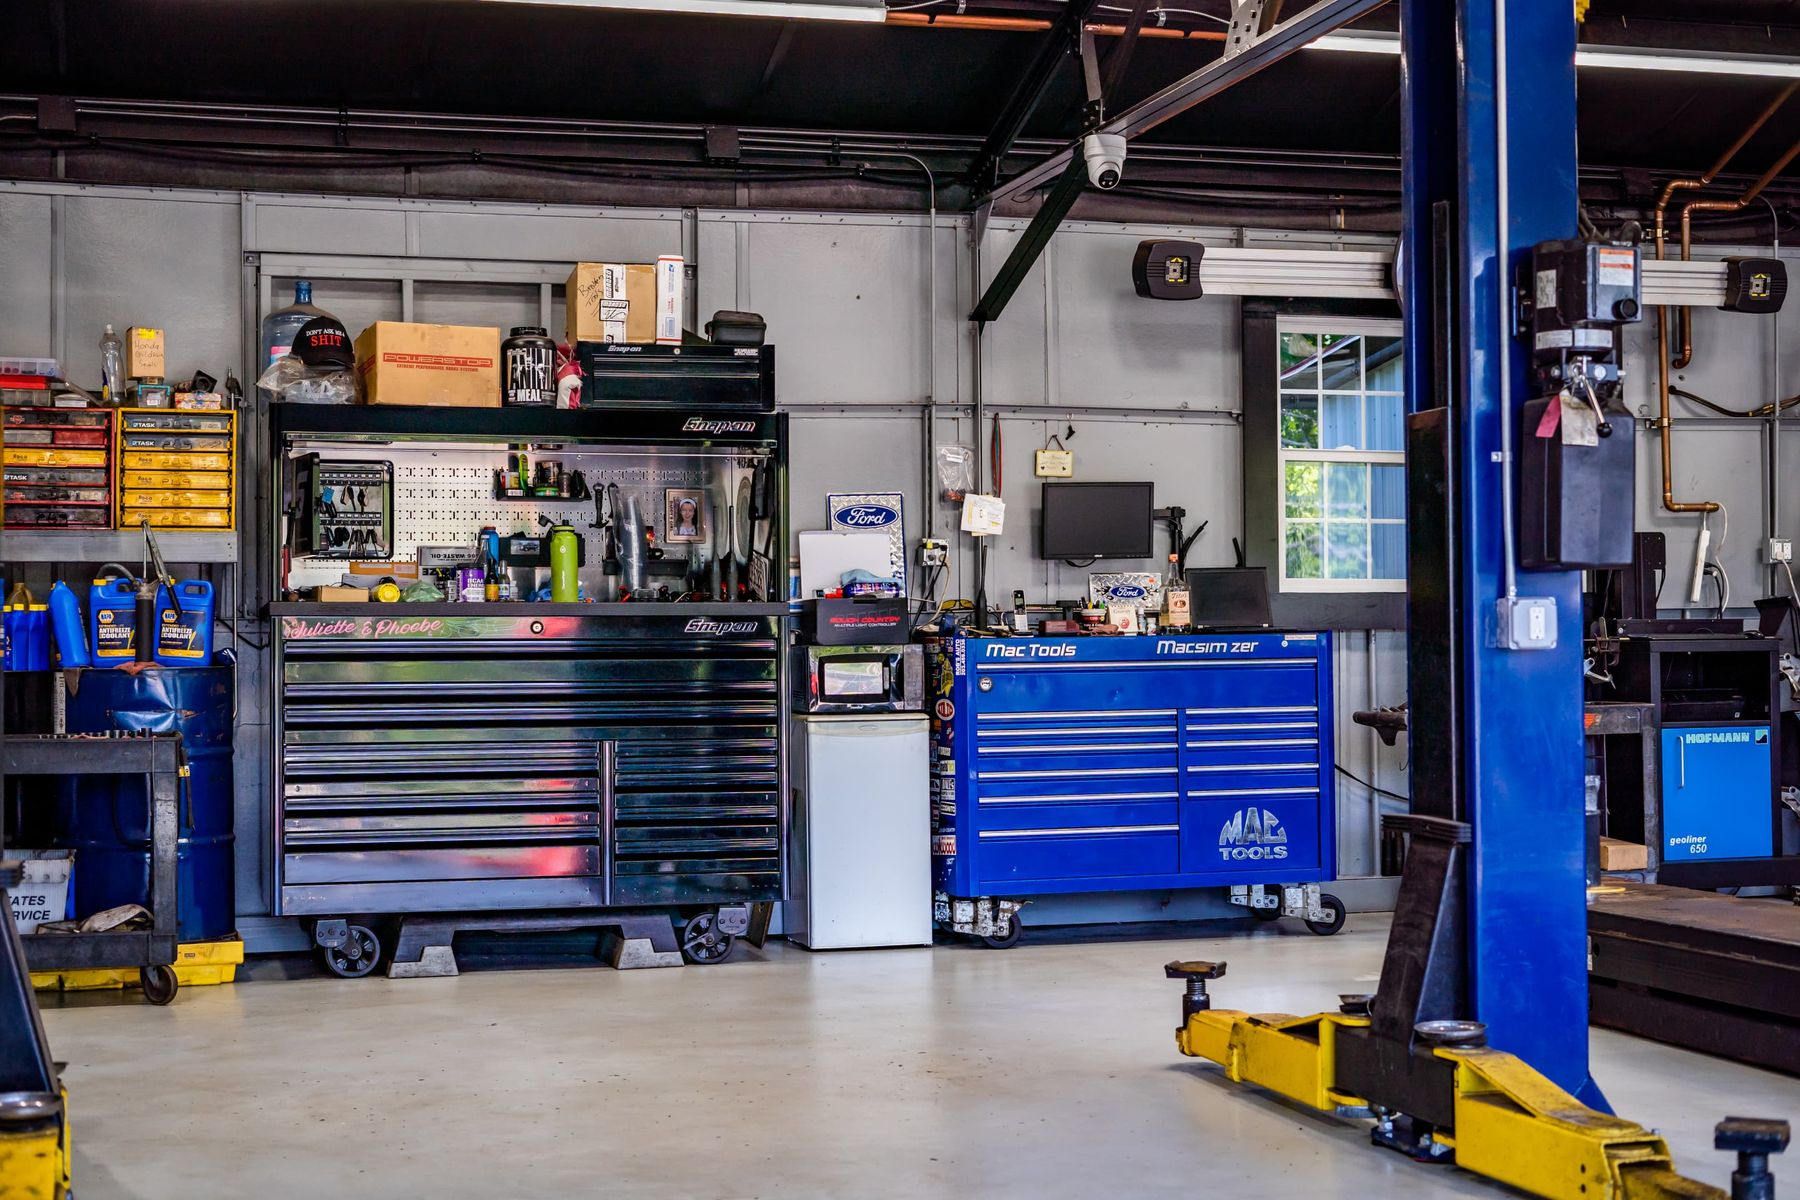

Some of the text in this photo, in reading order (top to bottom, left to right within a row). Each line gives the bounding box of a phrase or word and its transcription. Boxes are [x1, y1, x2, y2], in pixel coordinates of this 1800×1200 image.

[311, 334, 342, 347] SHIT
[517, 389, 541, 402] MEAL
[847, 508, 886, 524] Ford
[1117, 587, 1138, 597] Ford
[860, 616, 900, 624] COUNTRY
[291, 618, 443, 639] Juliette & Phoebe
[986, 643, 1077, 657] Mac Tools
[1686, 732, 1750, 744] HOFMANN
[1218, 807, 1288, 846] MAC
[1670, 836, 1706, 846] geoliner
[1218, 846, 1288, 860] TOOLS
[1690, 844, 1707, 853] 650
[8, 895, 46, 906] ATES
[13, 910, 51, 921] RVICE
